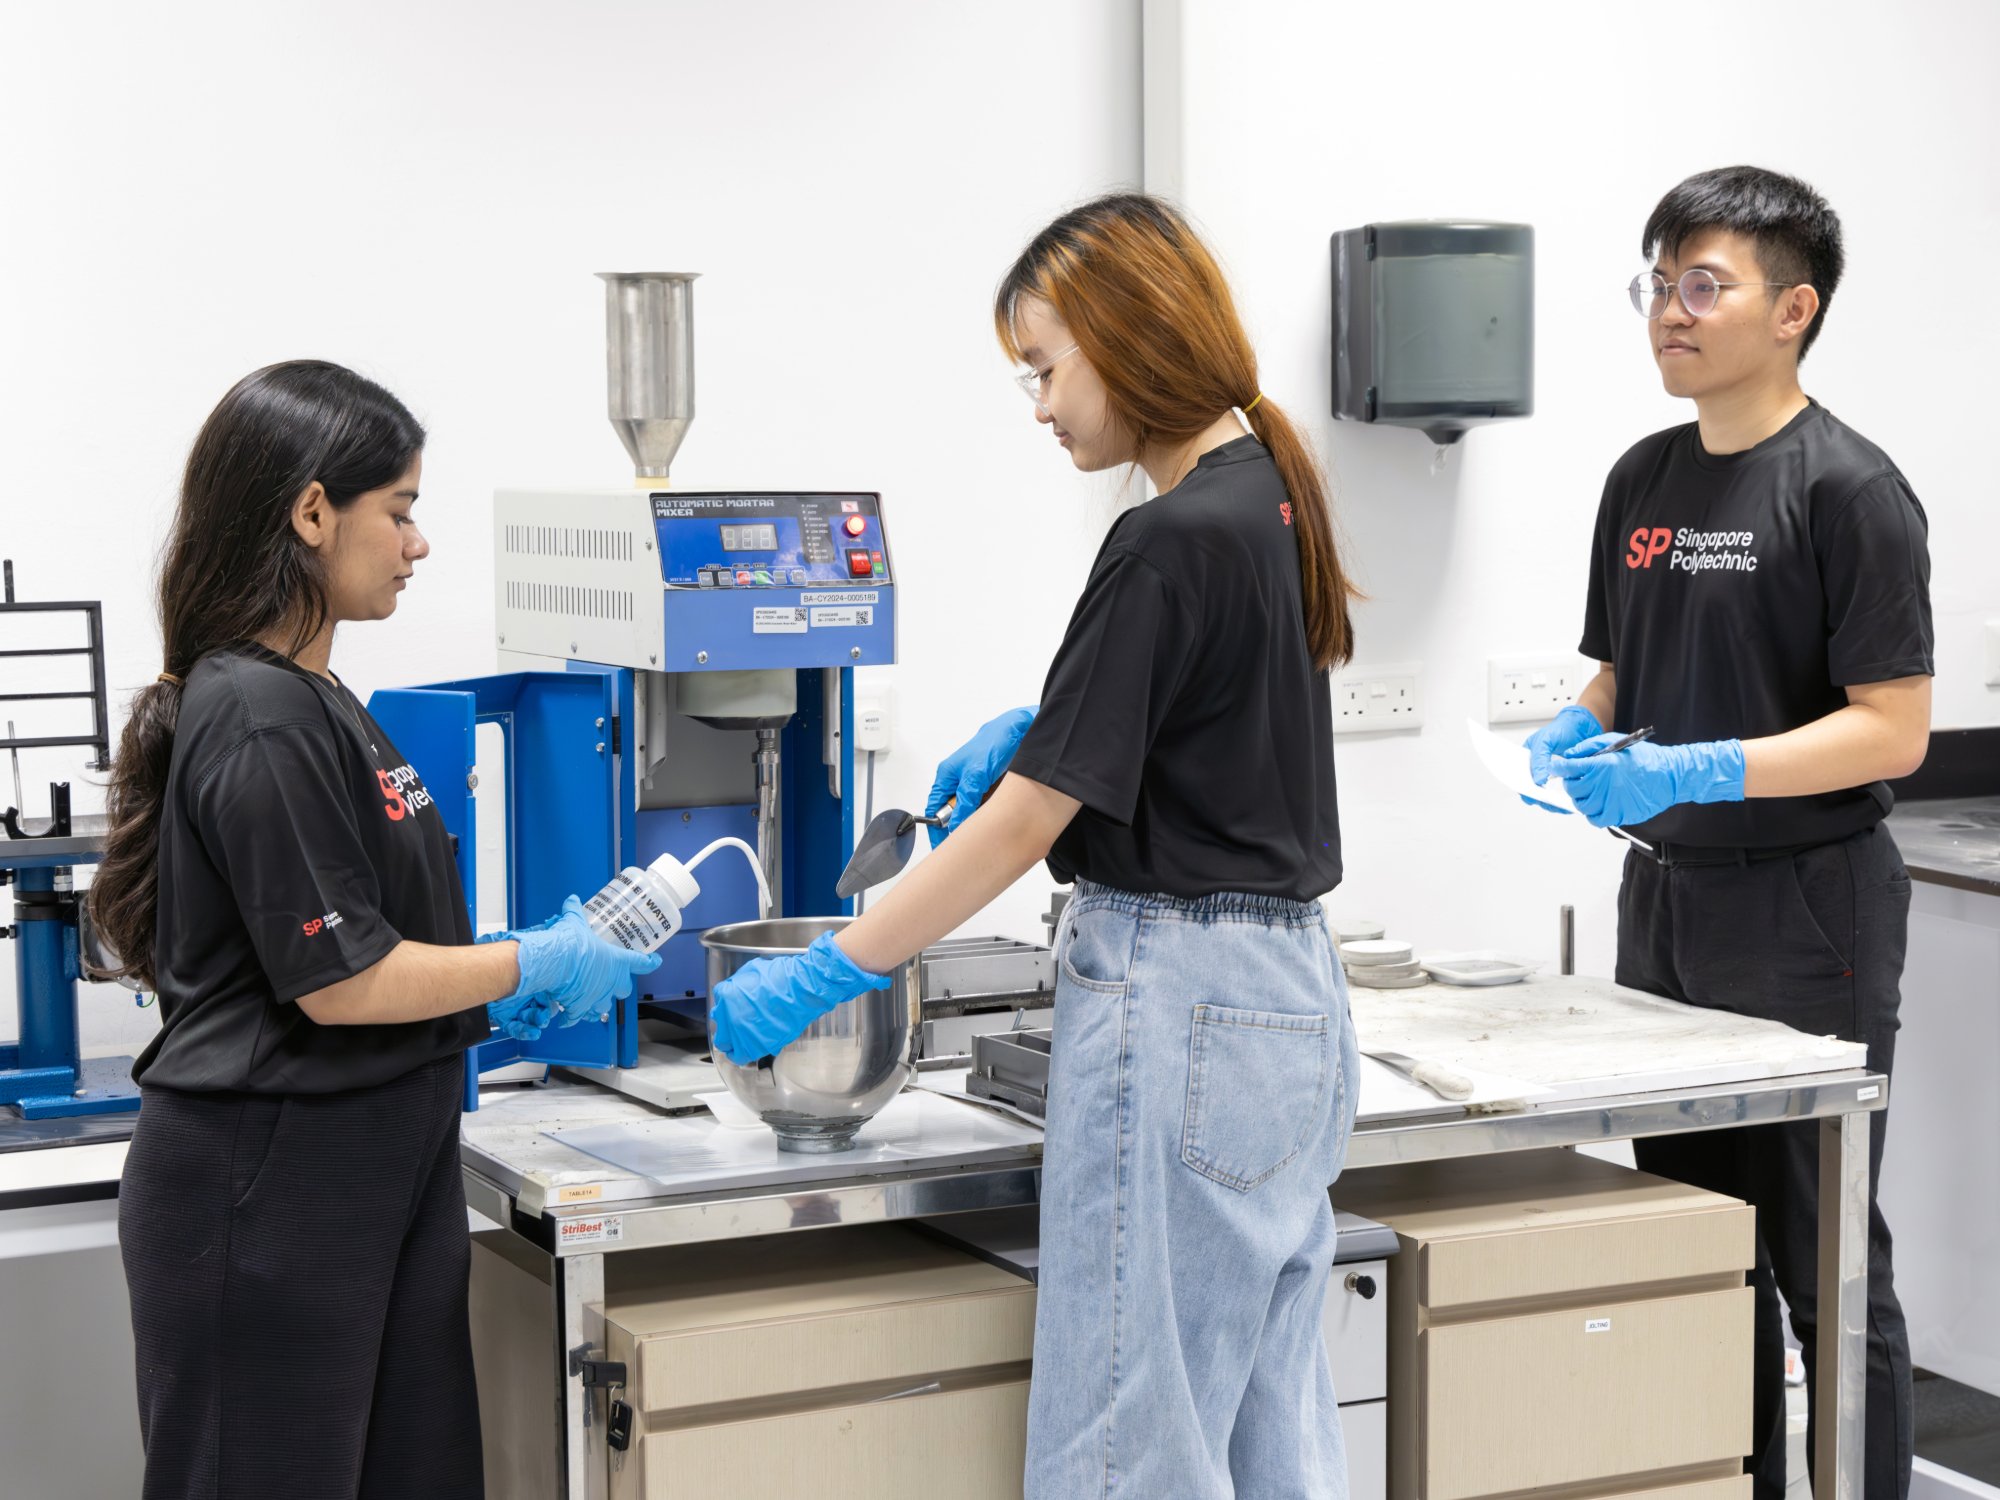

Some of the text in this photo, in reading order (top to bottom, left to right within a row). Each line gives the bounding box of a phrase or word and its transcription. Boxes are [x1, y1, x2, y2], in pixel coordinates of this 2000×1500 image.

[655, 499, 775, 508] AUTOMATIC MORTAR
[656, 508, 693, 516] MIXER
[1626, 527, 1753, 569] SP Singapore
[1670, 550, 1757, 574] Polytechnic
[646, 899, 672, 932] WATER
[303, 918, 323, 936] SP
[629, 921, 650, 948] WASSER
[561, 1222, 602, 1234] StriBest
